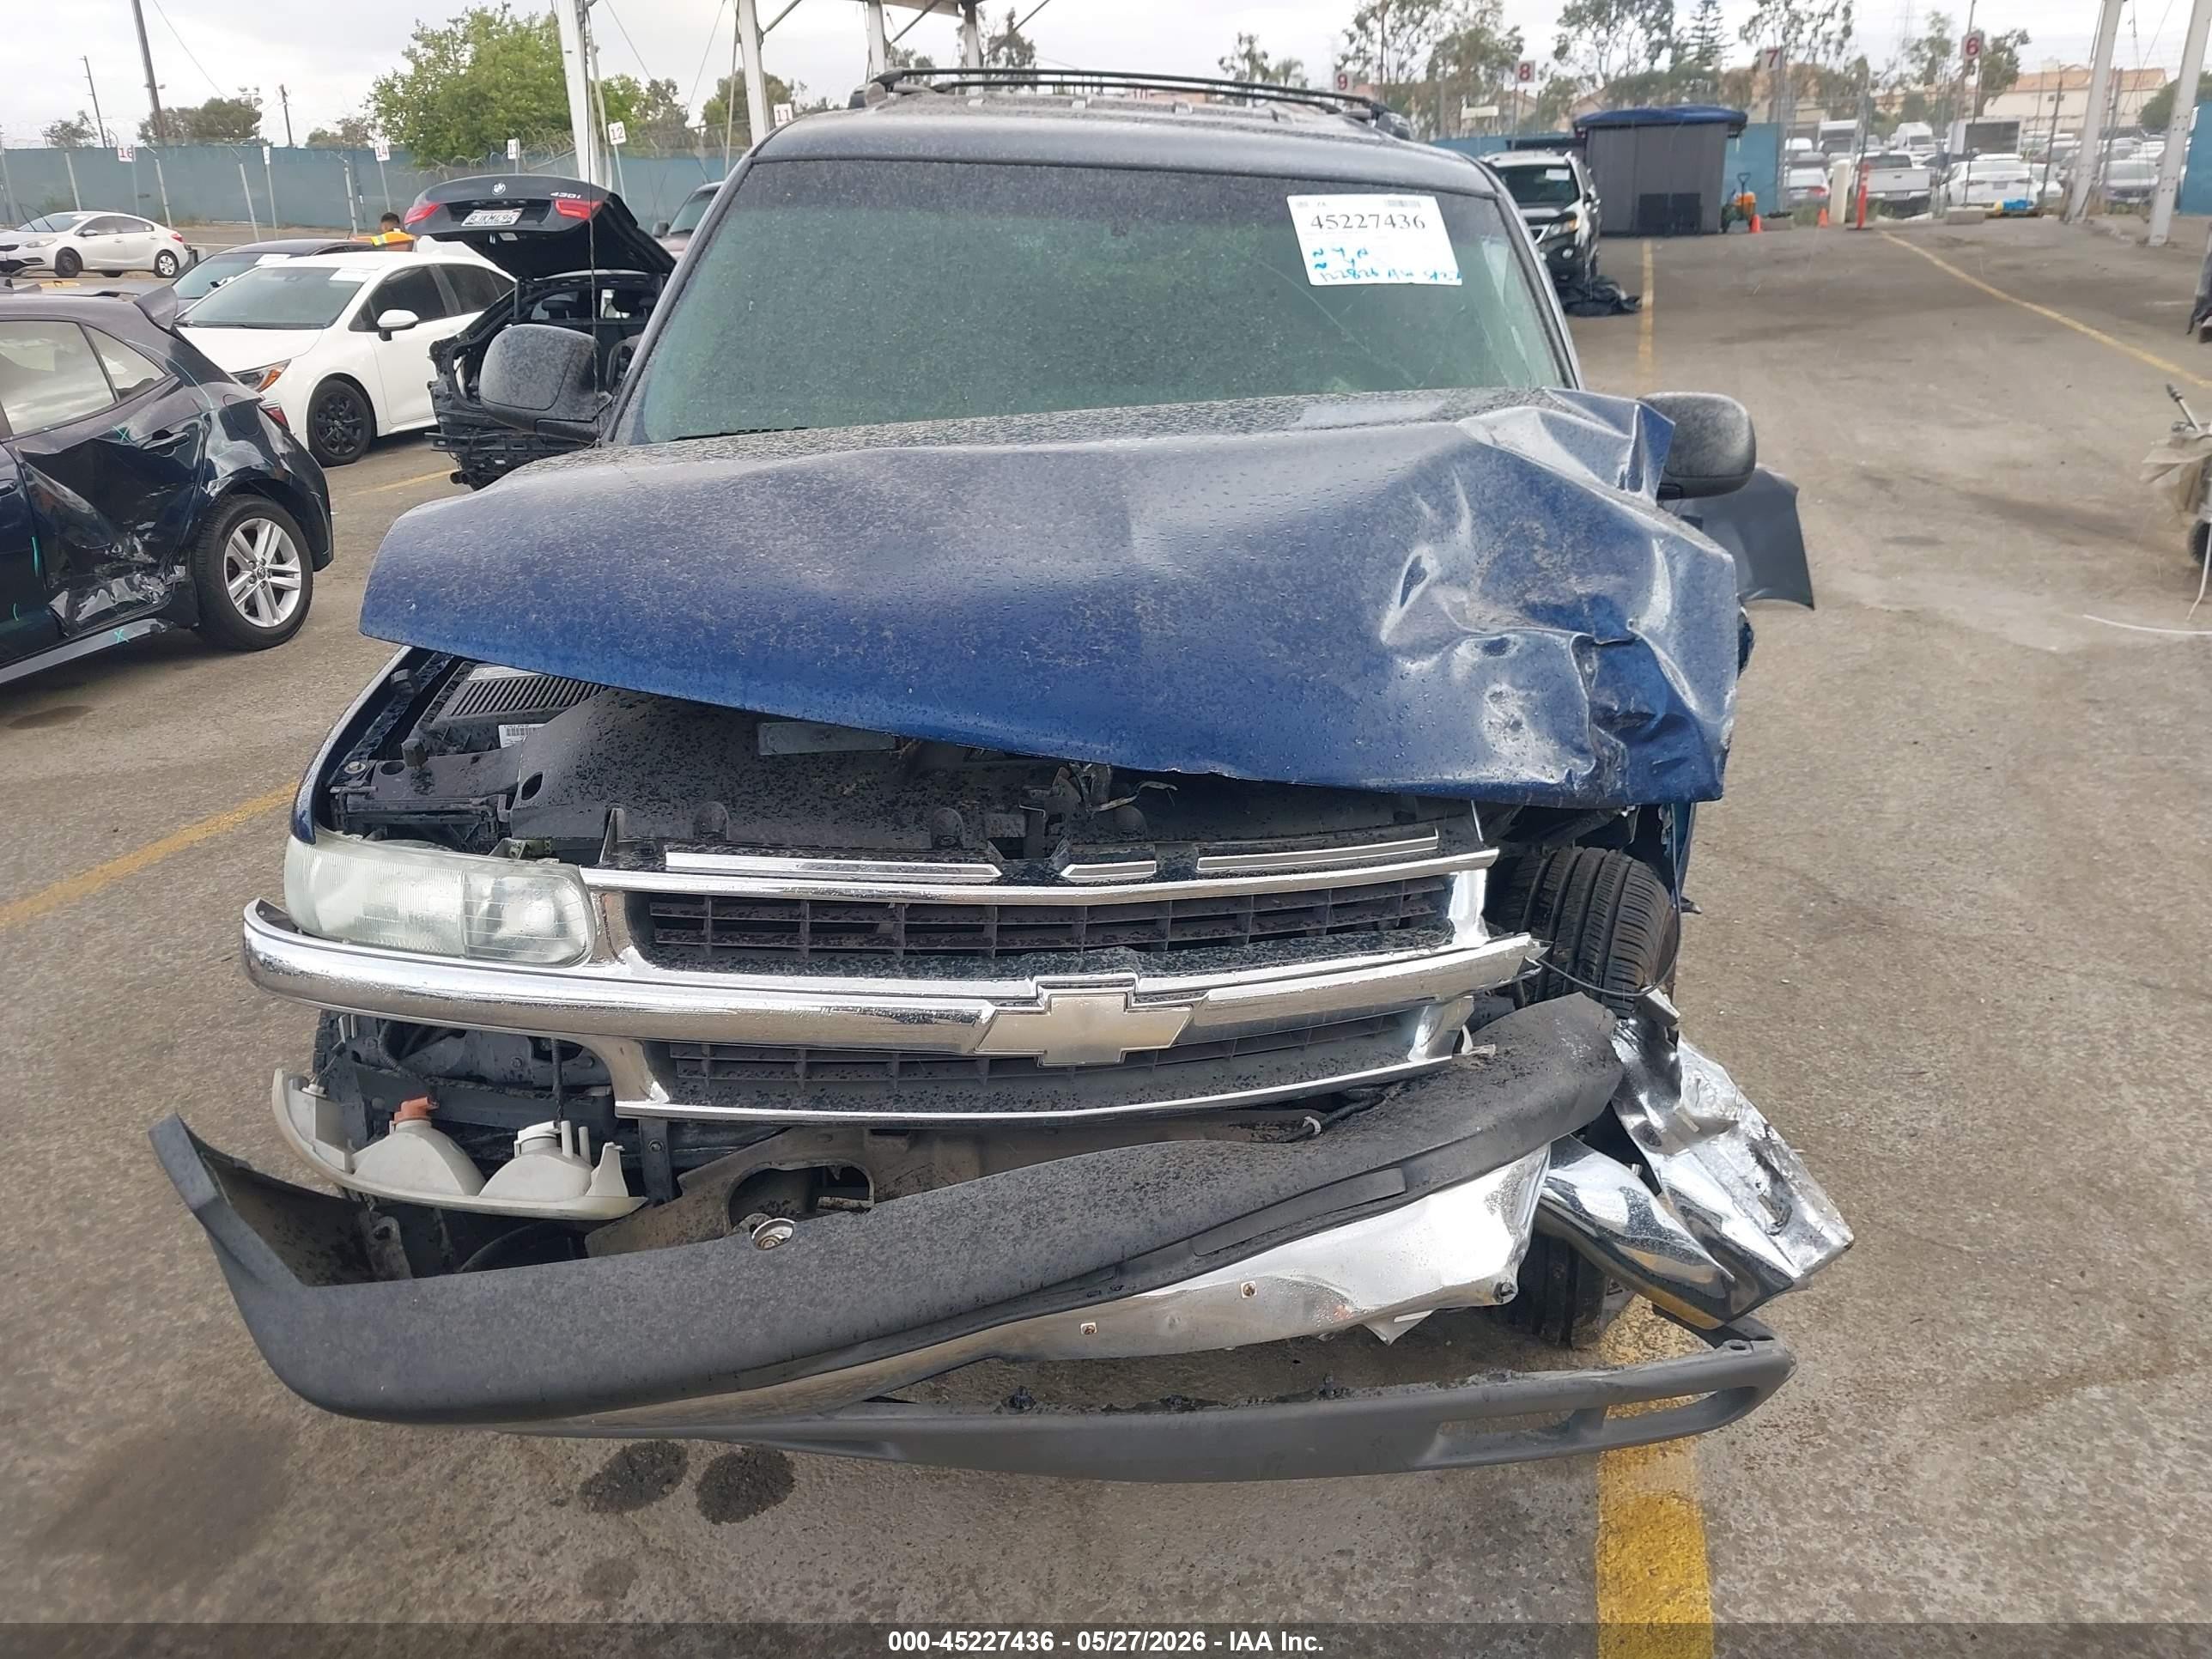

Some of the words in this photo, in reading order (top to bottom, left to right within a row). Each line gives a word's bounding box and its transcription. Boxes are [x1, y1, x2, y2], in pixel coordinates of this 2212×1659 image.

[1966, 37, 1979, 56] 6
[1765, 49, 1779, 68] 7
[1518, 63, 1530, 81] 8
[1338, 74, 1348, 90] 9
[776, 109, 790, 122] 11
[611, 126, 624, 140] 12
[376, 144, 388, 157] 14
[1310, 213, 1426, 229] 45227436
